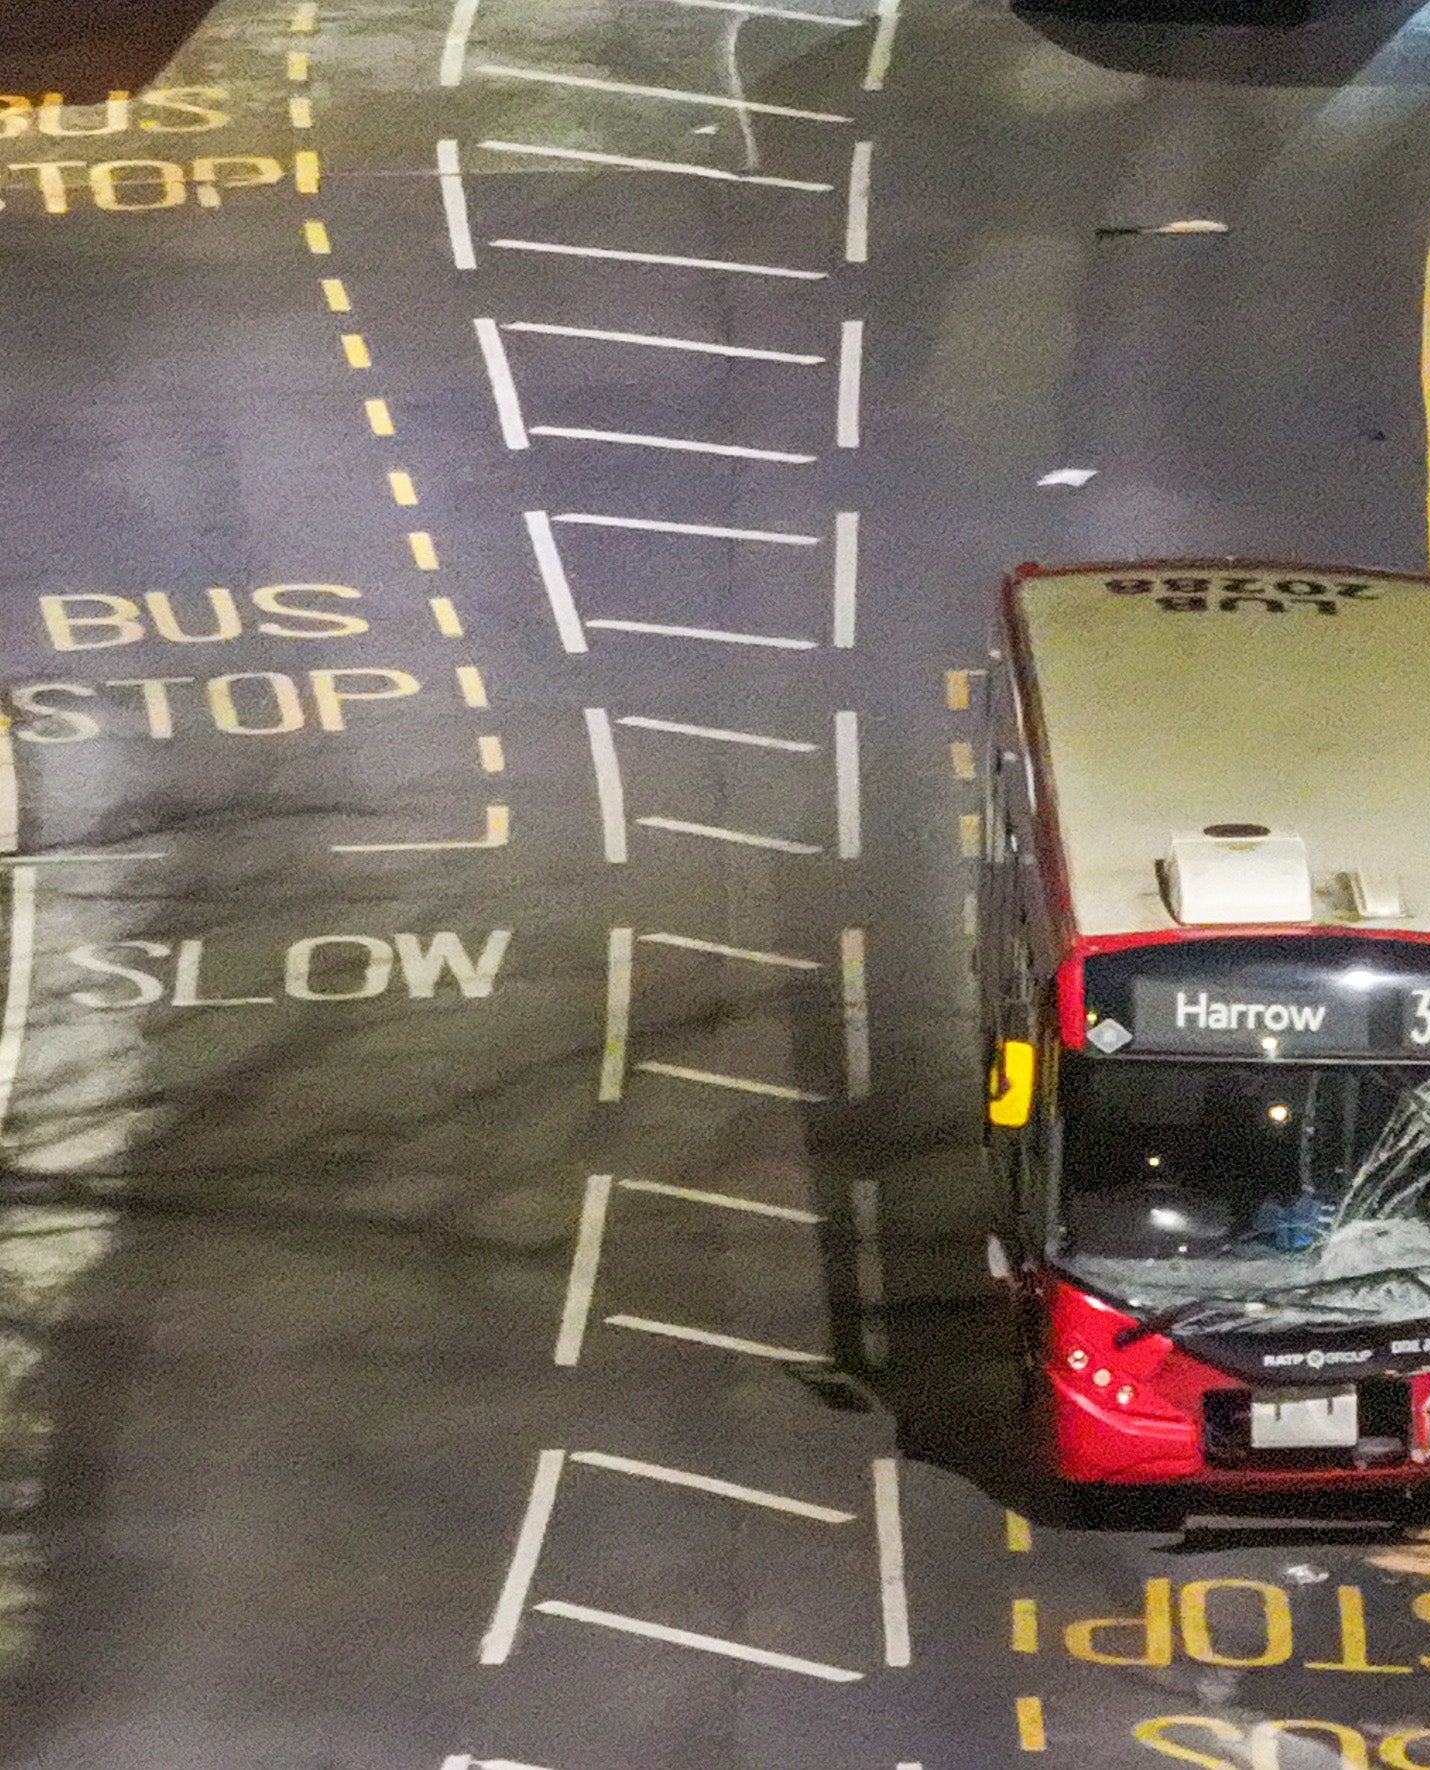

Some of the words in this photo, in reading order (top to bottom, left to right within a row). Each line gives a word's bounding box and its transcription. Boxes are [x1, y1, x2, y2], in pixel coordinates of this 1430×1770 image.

[0, 157, 285, 214] TOP
[38, 583, 370, 652] BUS
[8, 668, 422, 744] STOP
[67, 930, 512, 1008] SLOW
[1175, 992, 1326, 1032] Harrow
[1264, 1354, 1304, 1367] RATP
[1324, 1350, 1373, 1364] GROUP
